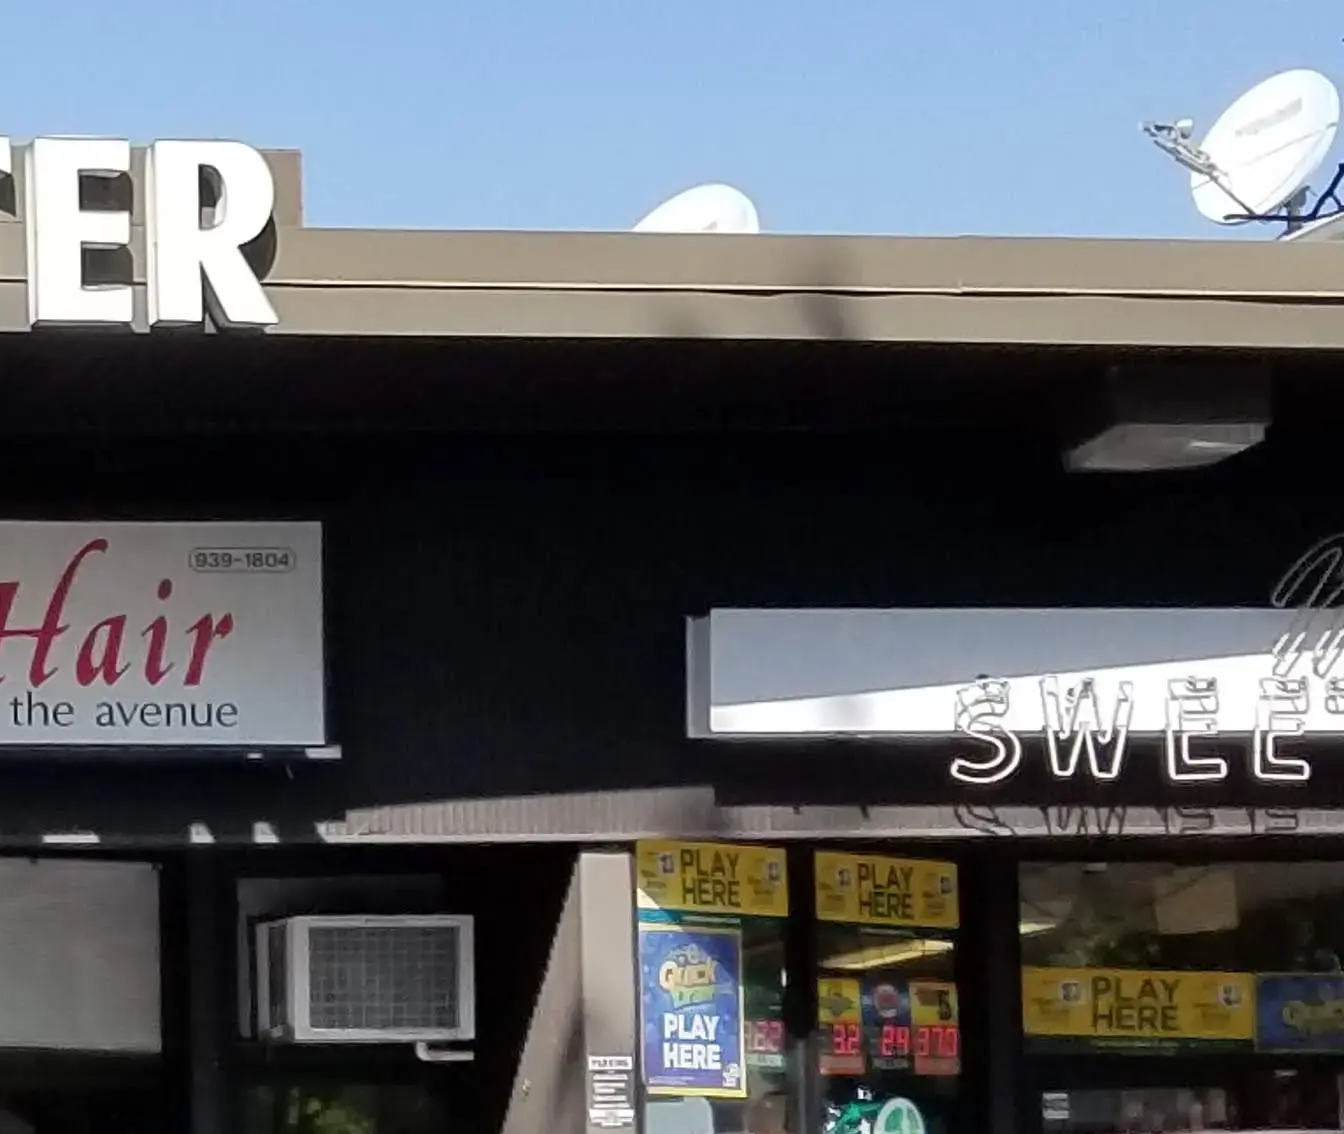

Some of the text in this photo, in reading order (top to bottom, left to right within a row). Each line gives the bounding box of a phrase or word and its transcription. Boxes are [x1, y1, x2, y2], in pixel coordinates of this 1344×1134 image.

[193, 551, 292, 571] 939-1804
[10, 690, 75, 727] the
[95, 698, 239, 728] avenue
[951, 676, 1344, 783] SWEE
[680, 849, 741, 876] PLAY
[857, 863, 914, 890] PLAY
[680, 878, 742, 907] HERE
[858, 890, 915, 920] HERE
[1090, 976, 1181, 1001] PLAY
[664, 1013, 721, 1041] PLAY
[1092, 1005, 1180, 1032] HERE
[664, 1043, 722, 1071] HERE
